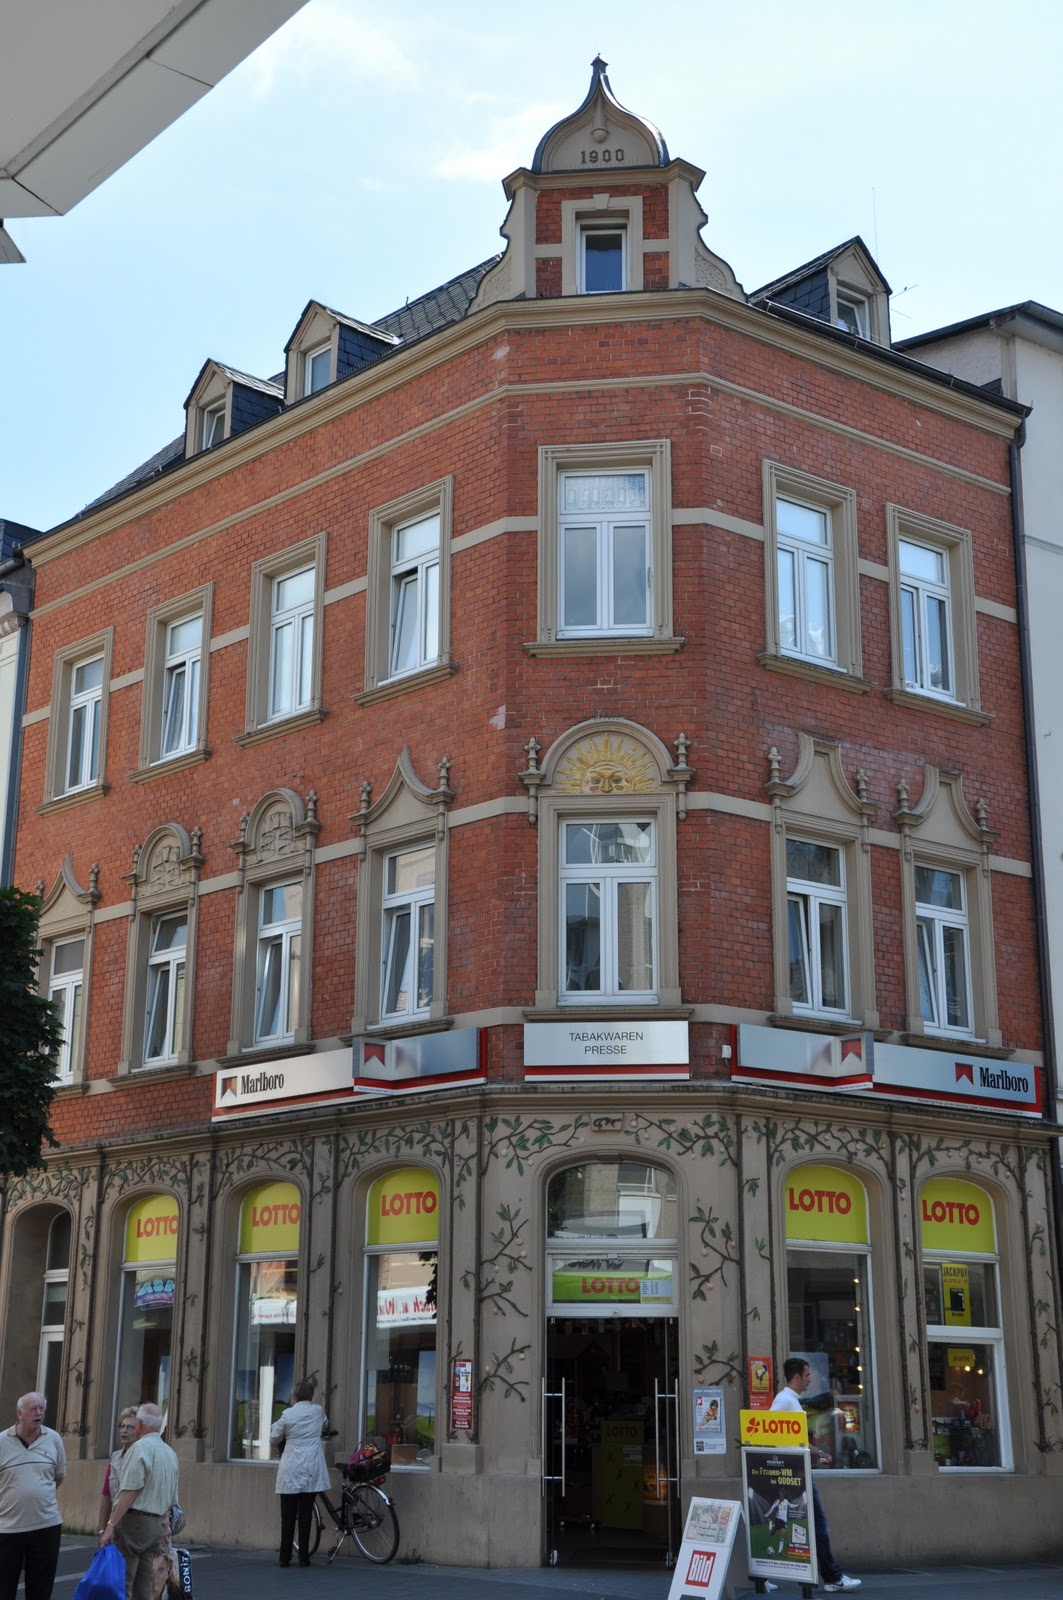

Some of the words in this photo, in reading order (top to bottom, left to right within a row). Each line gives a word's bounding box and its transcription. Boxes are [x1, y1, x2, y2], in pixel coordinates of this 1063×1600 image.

[580, 148, 624, 164] 1900
[568, 1031, 644, 1043] TABAKWAREN
[584, 1044, 628, 1056] PRESSE
[240, 1072, 285, 1096] Marlboro
[979, 1067, 1029, 1093] Marlboro
[382, 1191, 437, 1217] LOTTO
[789, 1187, 852, 1215] LOTTO
[252, 1202, 300, 1227] LOTTO
[922, 1199, 980, 1226] LOTTO
[136, 1216, 179, 1239] LOTTO
[943, 1266, 968, 1277] JACKPOT
[582, 1278, 640, 1294] LOTTO
[606, 1424, 638, 1438] LOTTO
[762, 1419, 802, 1435] LOTTO
[759, 1467, 793, 1477] Frauen-WM
[777, 1476, 802, 1487] ODDSET
[687, 1553, 714, 1583] Bild
